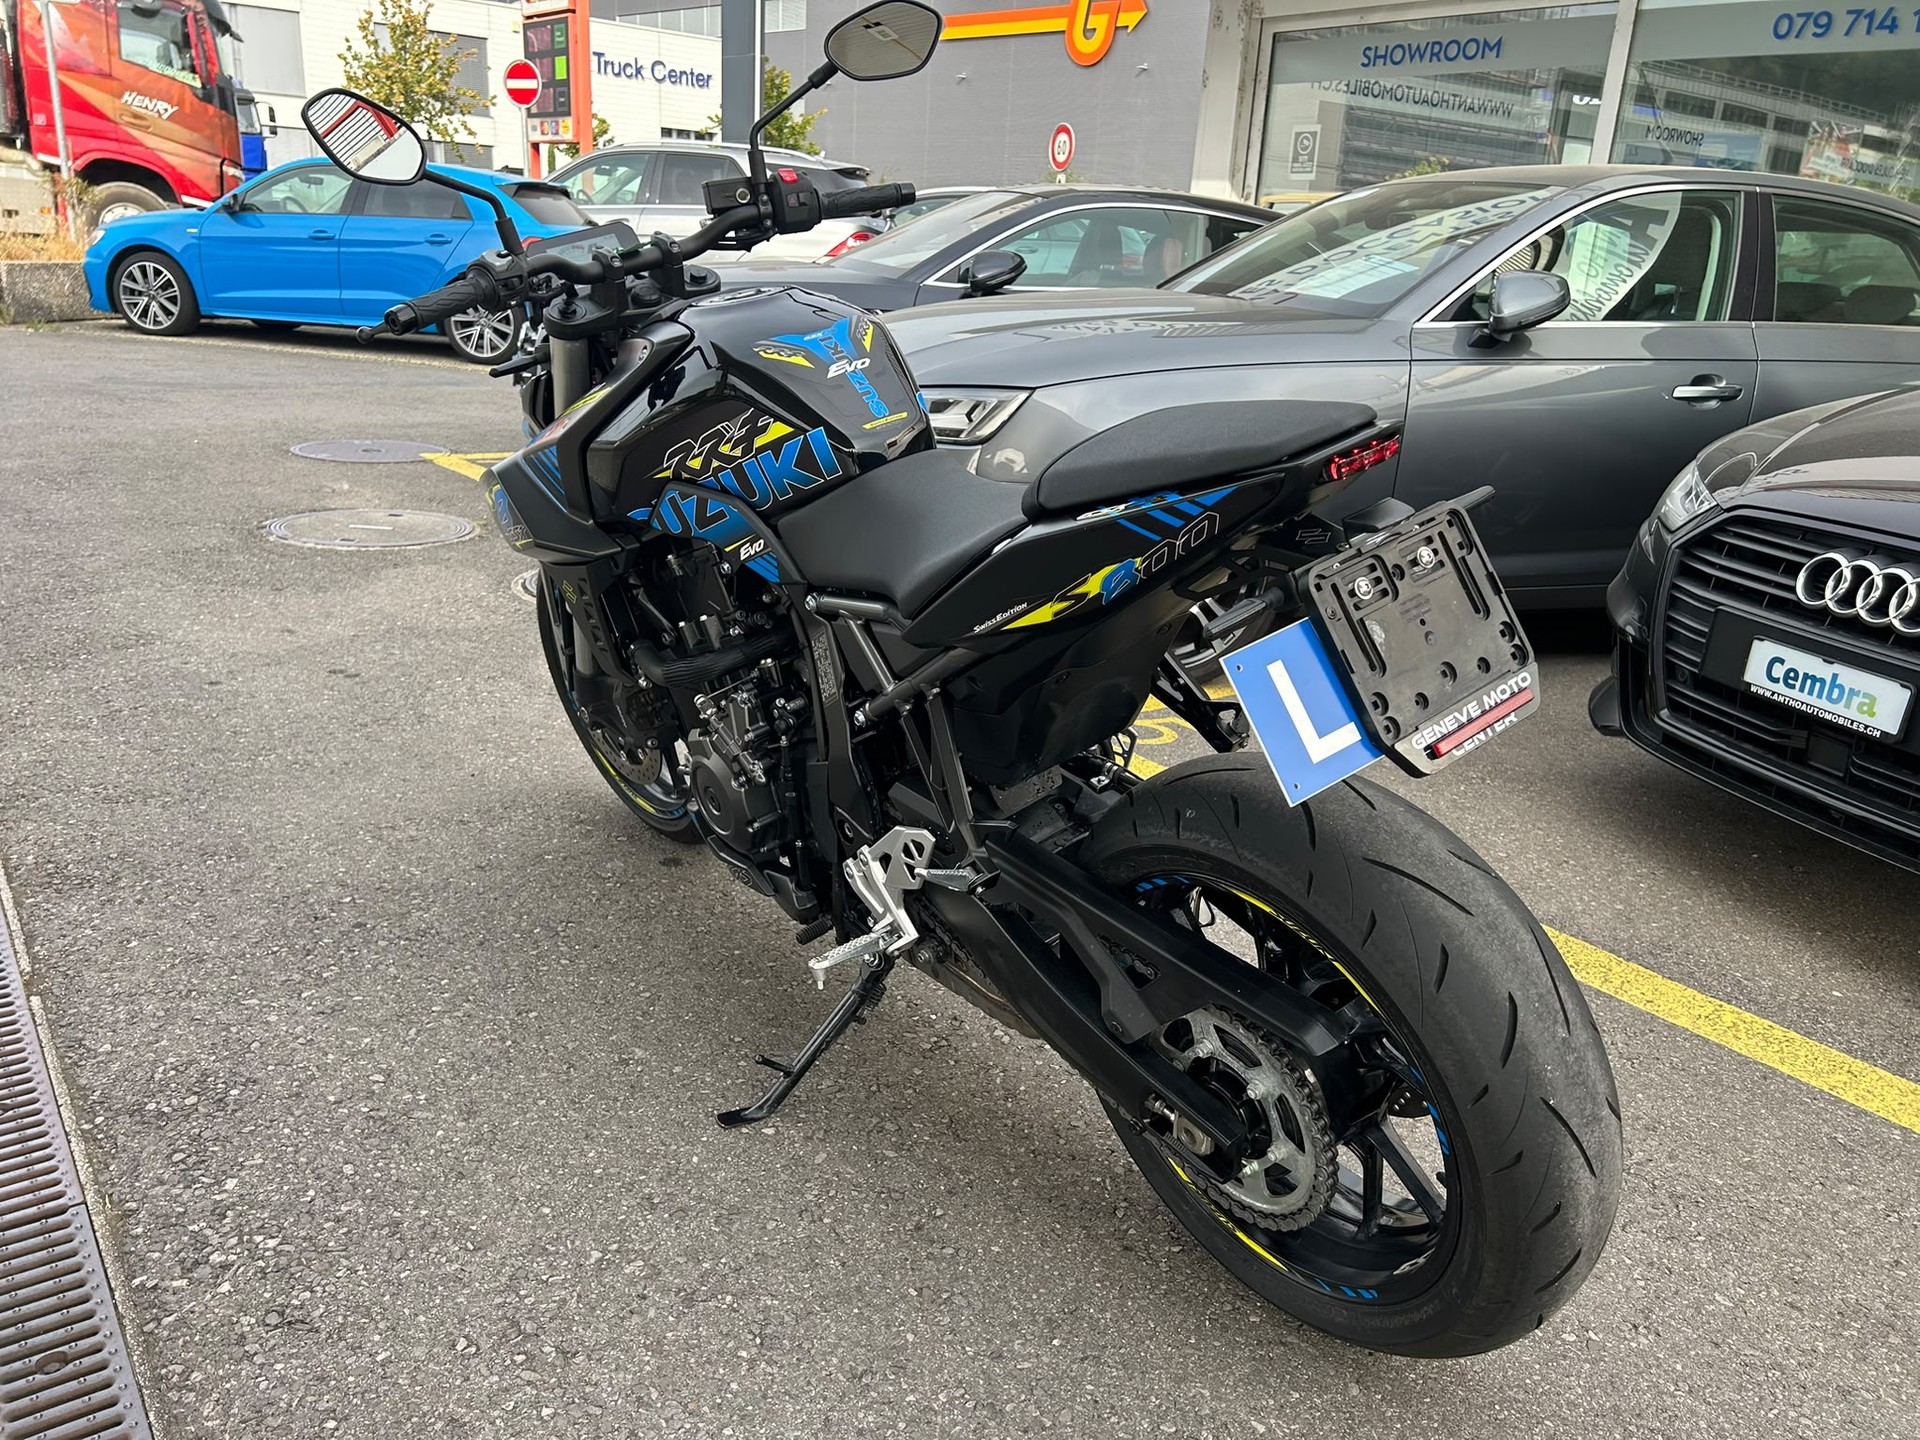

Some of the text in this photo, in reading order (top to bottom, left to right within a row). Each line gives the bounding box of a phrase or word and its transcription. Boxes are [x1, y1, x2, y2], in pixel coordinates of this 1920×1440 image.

[1772, 10, 1832, 40] 079
[1844, 7, 1898, 37] 714
[592, 51, 712, 89] Truck Center
[1360, 36, 1503, 68] SHOWROOM
[121, 91, 179, 119] HENRY
[1765, 656, 1877, 718] Cembra
[1266, 659, 1362, 765] L
[1411, 671, 1532, 750] GENEVE MOTO
[1750, 684, 1881, 738] WWW.ANTHOAUTOMOBILES.CH
